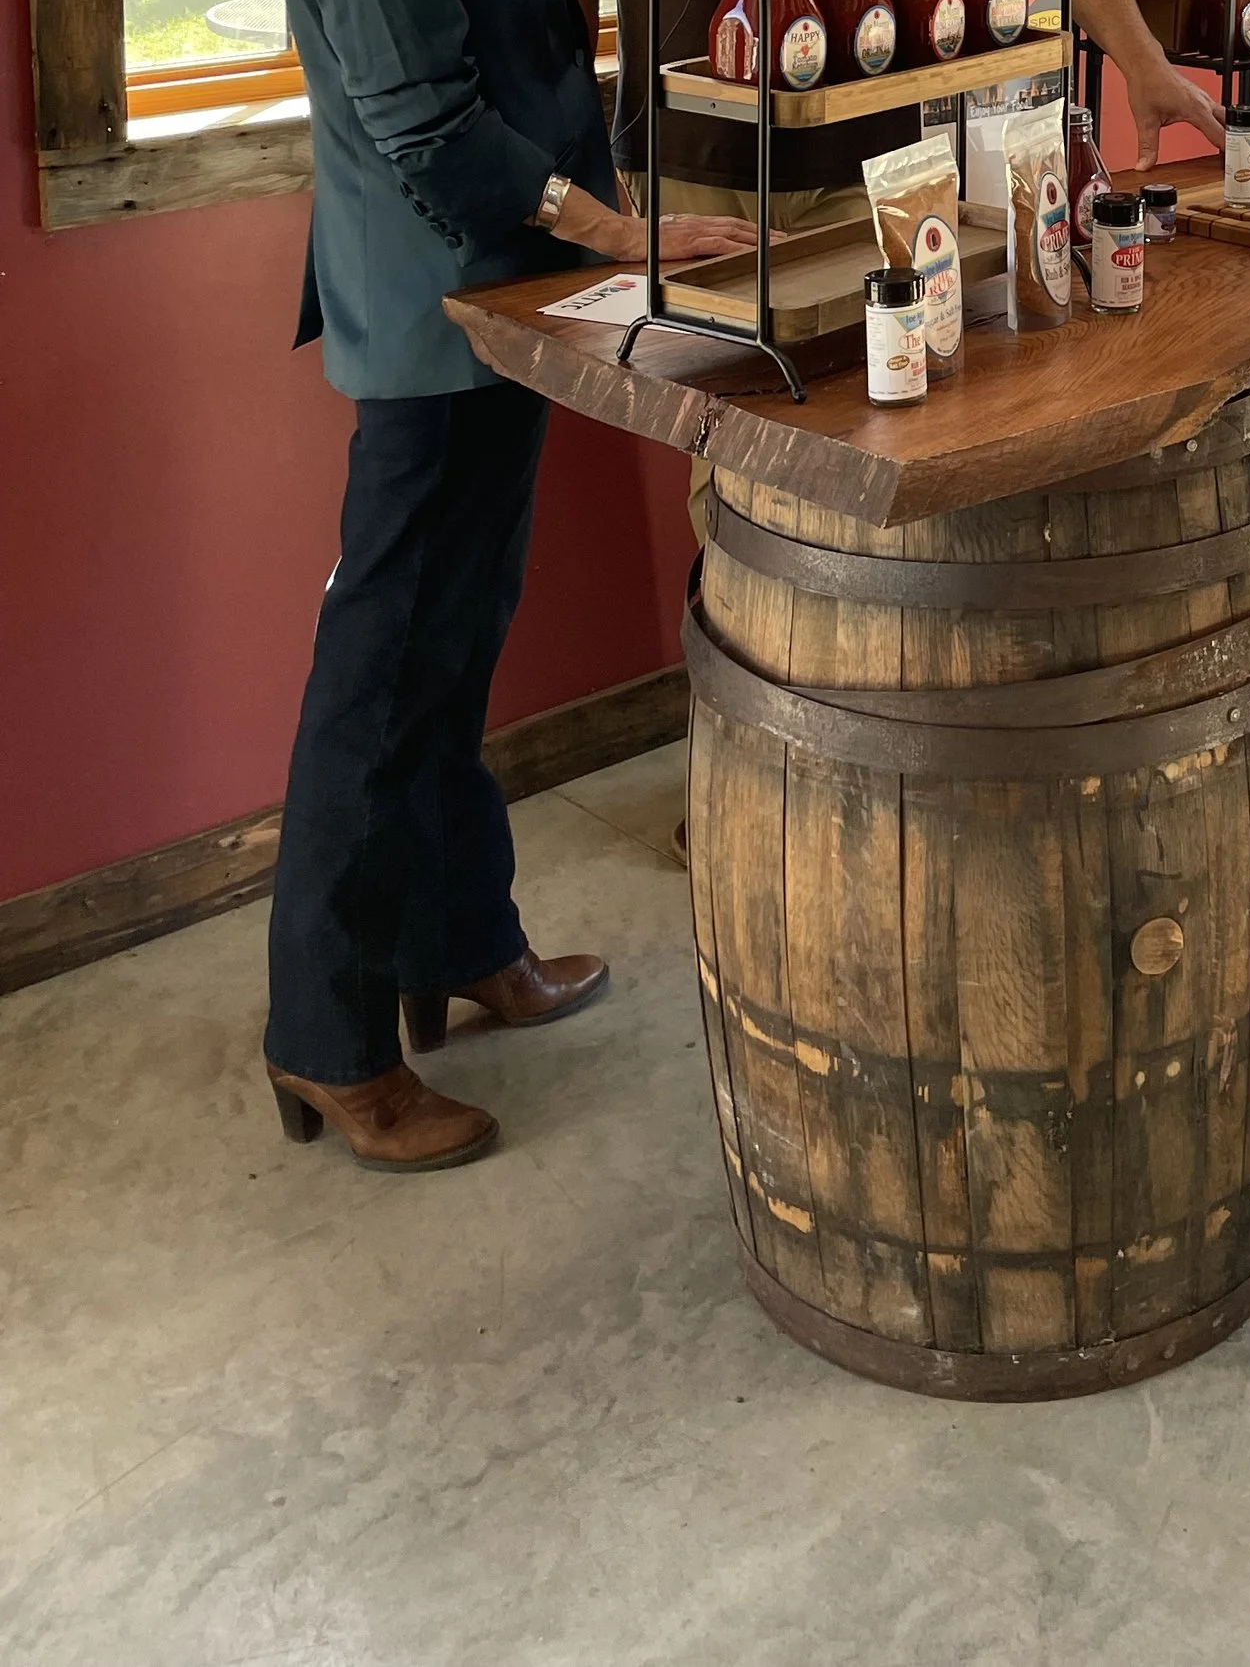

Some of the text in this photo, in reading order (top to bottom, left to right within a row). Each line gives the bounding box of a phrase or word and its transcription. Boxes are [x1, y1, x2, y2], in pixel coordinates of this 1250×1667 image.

[1030, 15, 1060, 28] SPIC
[791, 31, 820, 43] HAPPY
[1116, 251, 1143, 266] PRIM
[929, 275, 954, 295] RUB
[905, 334, 921, 349] The
